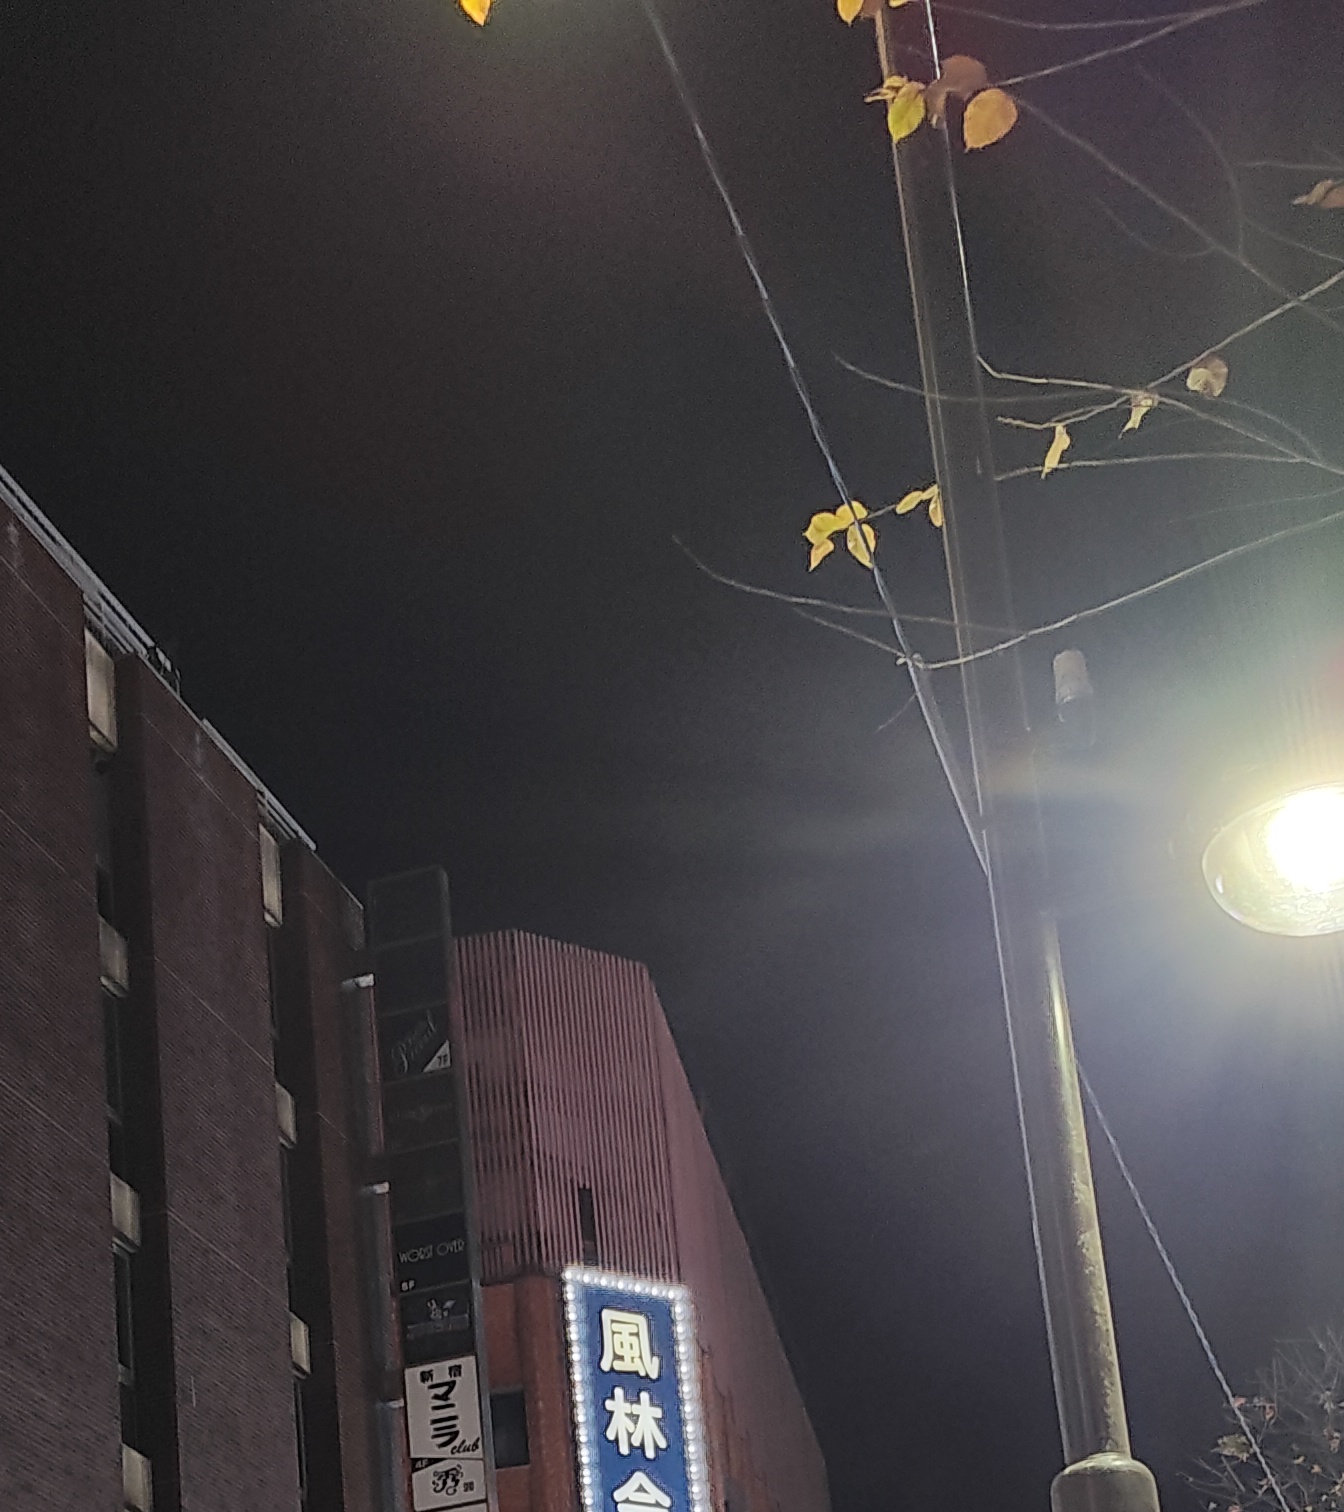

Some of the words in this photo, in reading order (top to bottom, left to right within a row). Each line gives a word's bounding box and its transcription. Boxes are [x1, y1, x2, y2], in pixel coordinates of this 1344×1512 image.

[436, 1239, 465, 1257] OVER
[426, 1380, 460, 1449] マニラ
[450, 1437, 480, 1456] club
